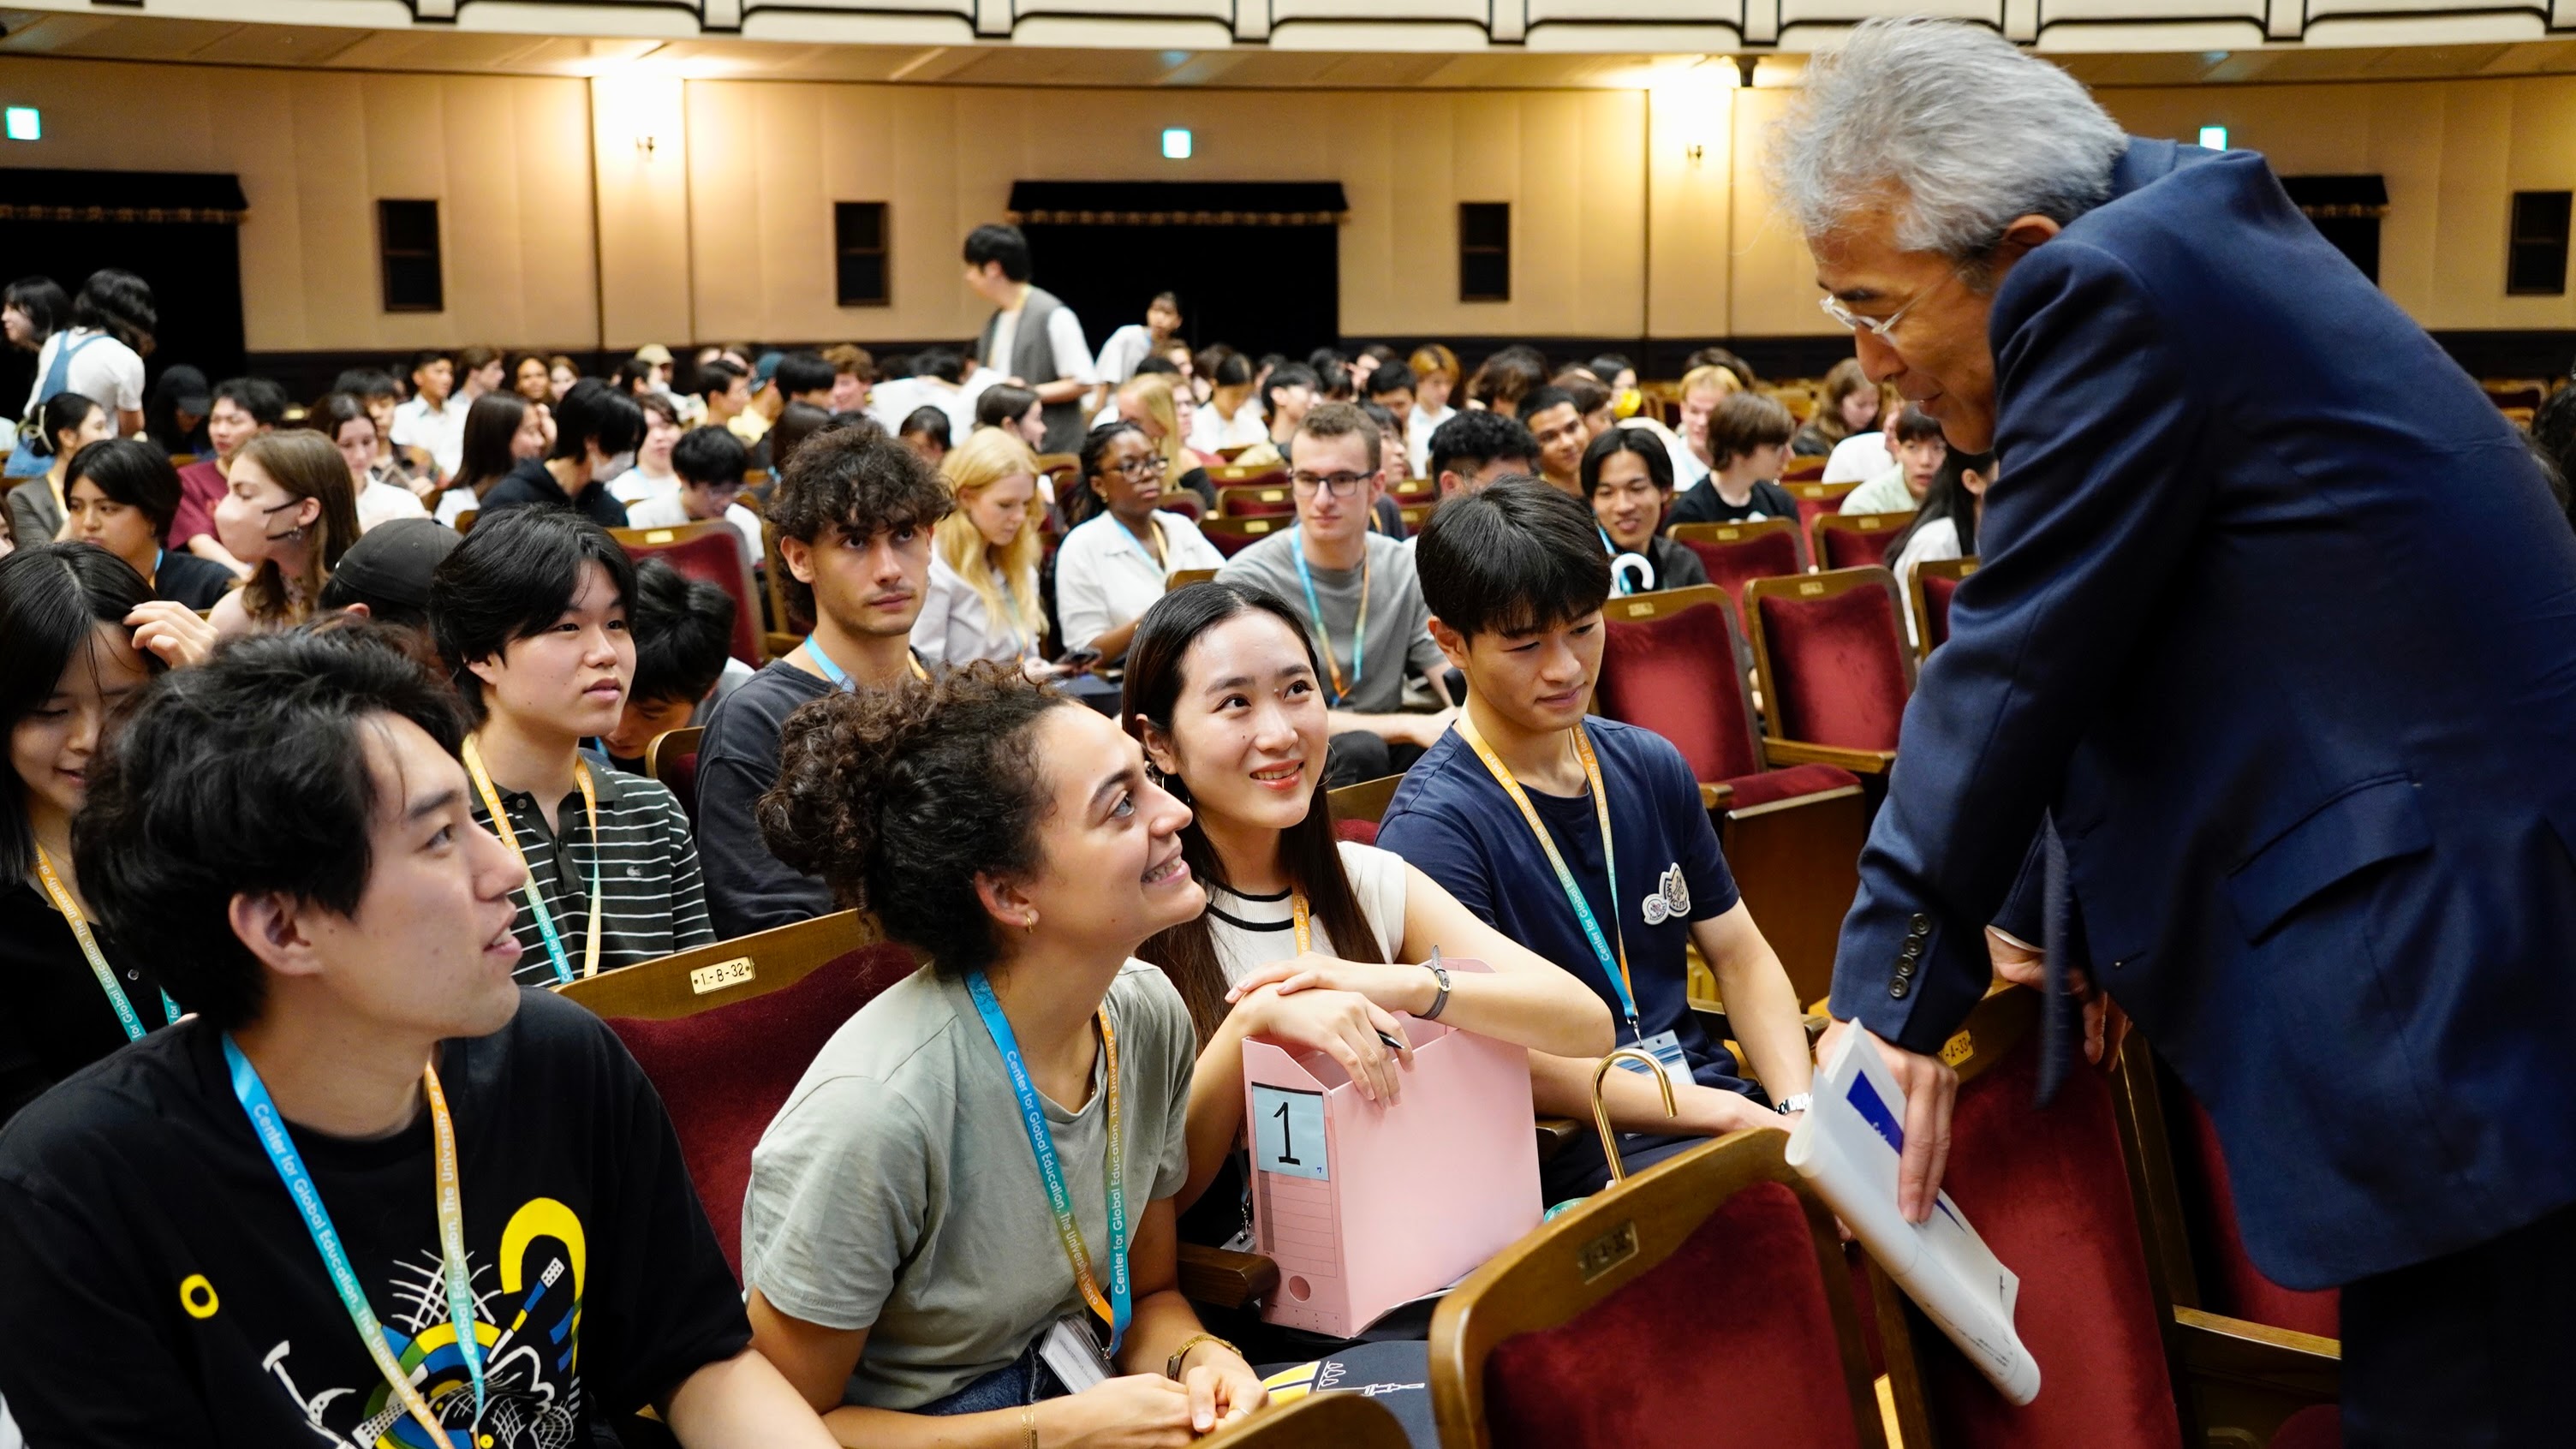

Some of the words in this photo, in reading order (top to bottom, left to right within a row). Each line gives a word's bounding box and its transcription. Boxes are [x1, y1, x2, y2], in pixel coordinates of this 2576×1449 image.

[1486, 753, 1508, 778] Tokyo
[1504, 776, 1512, 786] of
[1511, 786, 1538, 826] University
[1536, 826, 1547, 841] The
[40, 865, 50, 875] of
[1547, 841, 1573, 887] Education,
[46, 877, 77, 918] University
[1569, 886, 1588, 917] Global
[75, 920, 87, 937] The
[536, 908, 553, 938] Global
[1585, 919, 1595, 933] for
[547, 939, 558, 953] for
[1591, 932, 1610, 961] Center
[86, 939, 115, 990] Education,
[552, 952, 570, 981] Center
[110, 989, 134, 1023] Global
[129, 1023, 141, 1038] for
[1103, 1020, 1110, 1031] of
[1007, 1050, 1028, 1092] Center
[1108, 1035, 1118, 1094] University
[1023, 1093, 1035, 1111] for
[438, 1110, 454, 1182] University
[1029, 1112, 1049, 1152] Global
[1273, 1101, 1300, 1166] 1
[1111, 1120, 1120, 1185] Education,
[1041, 1151, 1064, 1213] Education,
[444, 1187, 456, 1214] The
[1112, 1188, 1123, 1231] Global
[1058, 1212, 1070, 1231] The
[253, 1103, 288, 1155] Center
[281, 1154, 298, 1177] for
[294, 1178, 326, 1230] Global
[319, 1230, 359, 1309] Education,
[358, 1307, 375, 1335] The
[372, 1335, 415, 1401] University
[1066, 1231, 1088, 1274] University
[1113, 1235, 1123, 1249] for
[447, 1217, 467, 1300] Education,
[1115, 1252, 1125, 1295] Center
[1081, 1273, 1089, 1281] of
[1083, 1278, 1098, 1305] Tokyo
[456, 1305, 475, 1355] Global
